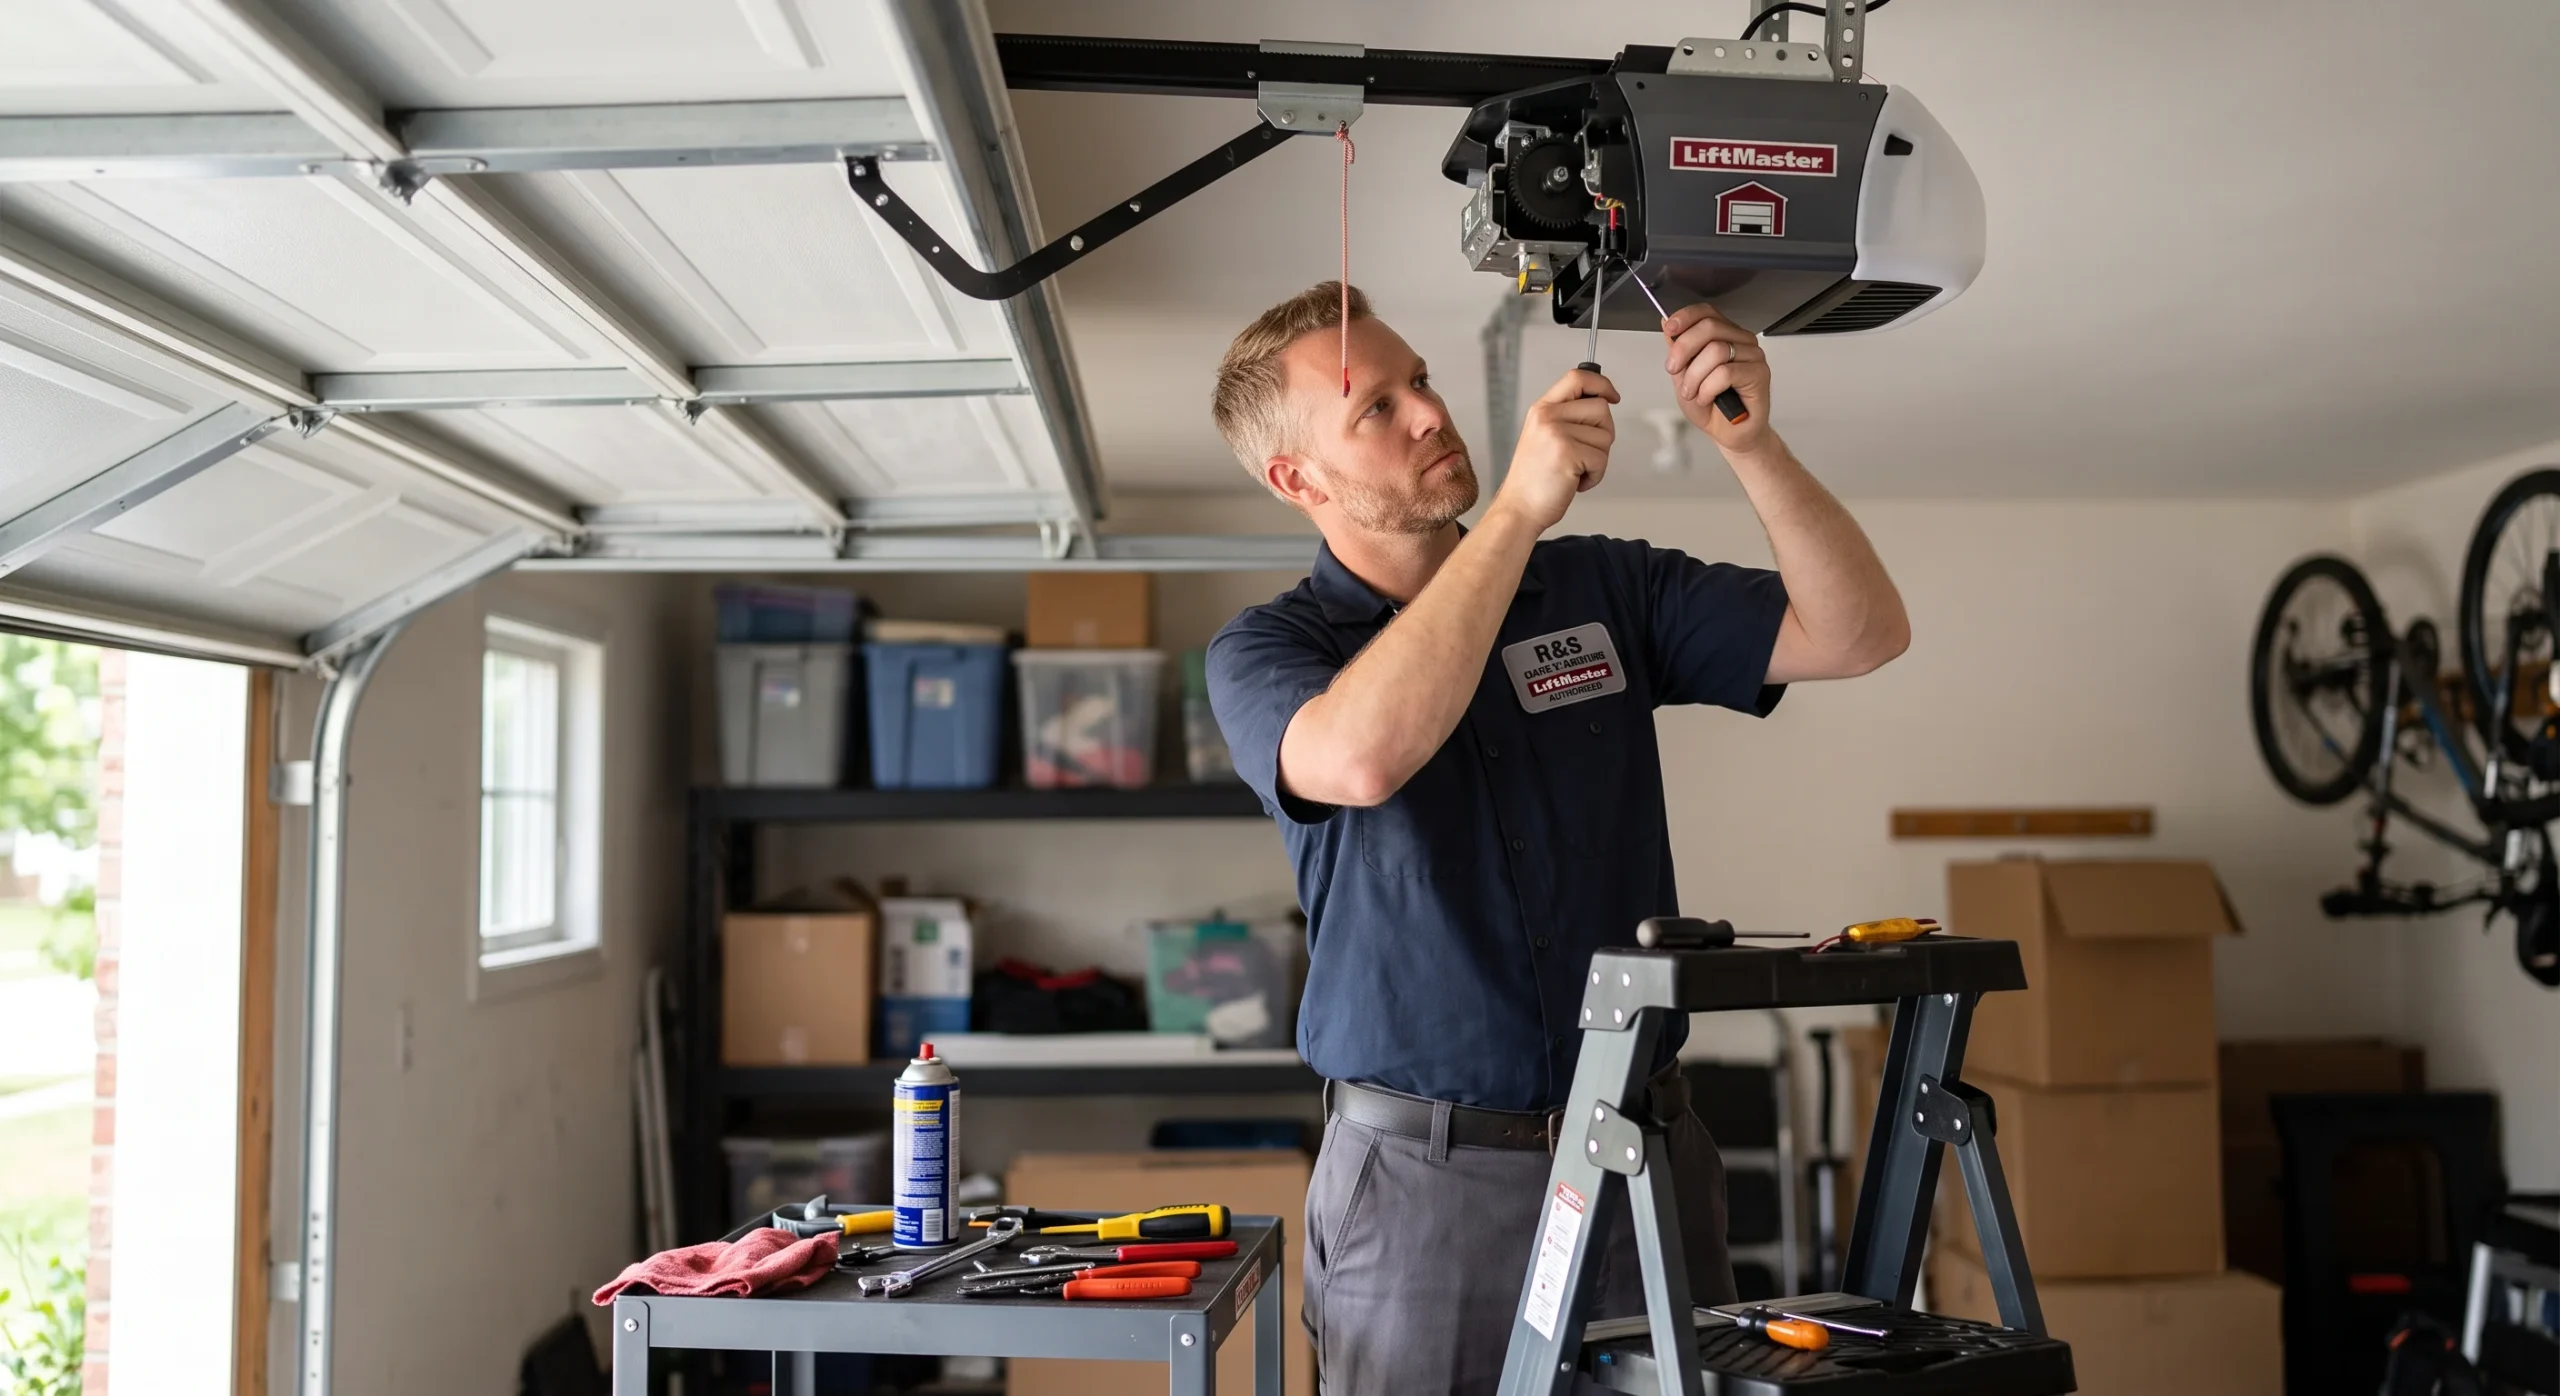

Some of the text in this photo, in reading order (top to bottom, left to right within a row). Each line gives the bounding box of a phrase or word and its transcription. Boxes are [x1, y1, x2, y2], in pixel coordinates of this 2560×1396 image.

[1684, 145, 1824, 169] LiftMaster
[1534, 637, 1582, 663] R&S
[1533, 668, 1608, 694] LiftMaster
